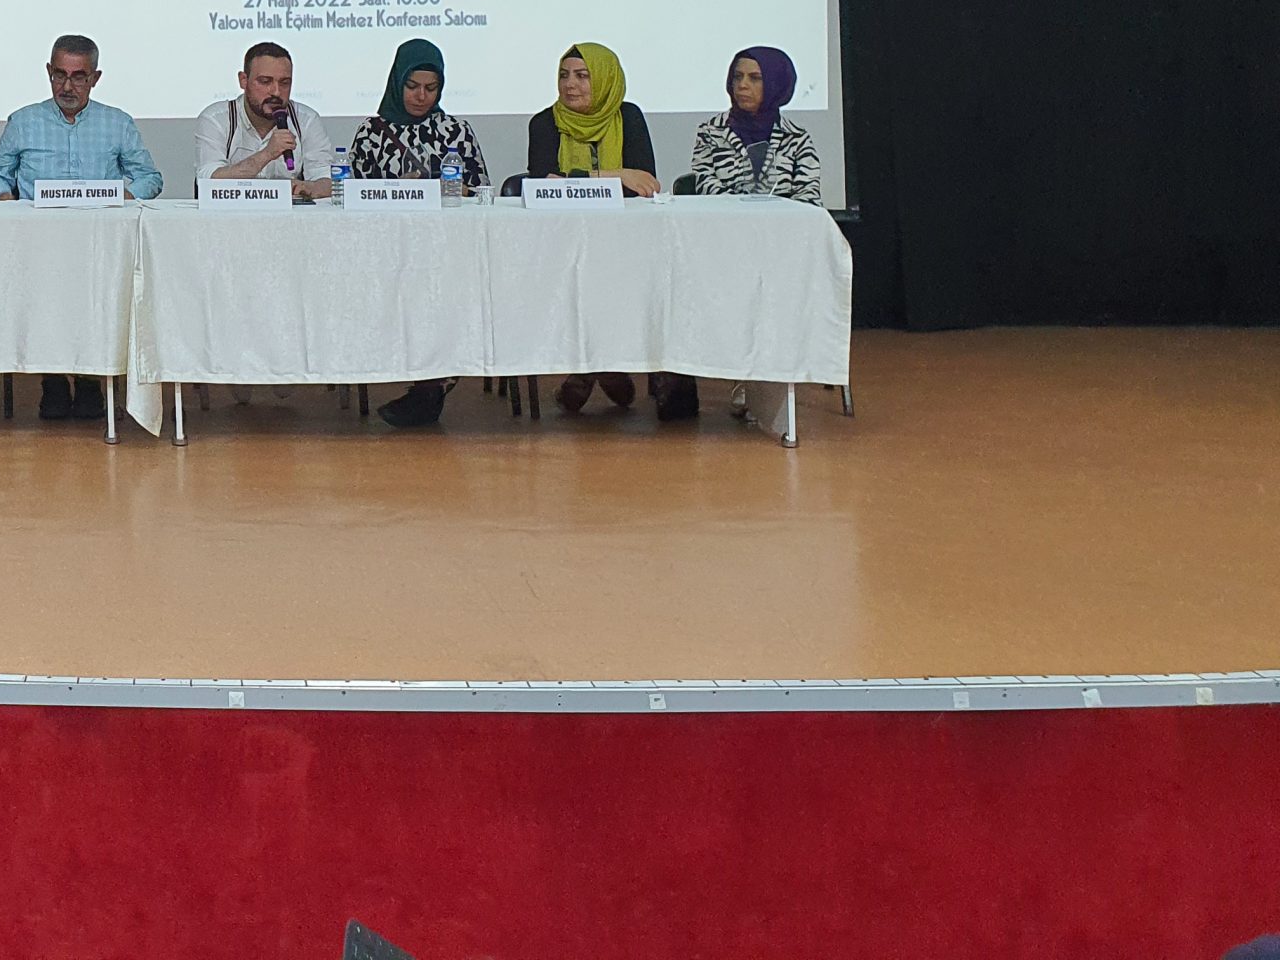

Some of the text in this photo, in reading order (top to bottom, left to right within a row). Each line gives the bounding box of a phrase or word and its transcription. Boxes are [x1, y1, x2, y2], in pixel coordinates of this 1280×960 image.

[209, 12, 254, 30] Yalova
[257, 11, 282, 29] Halk
[326, 10, 373, 29] Merkez
[376, 9, 441, 27] Konferans
[444, 8, 487, 26] Salonu
[40, 187, 118, 199] MUSTAFA EVERDİ
[211, 189, 279, 199] RECEP KAYALI
[360, 189, 424, 200] SEMA BAYAR
[535, 186, 612, 199] ARZU ÖZDEMİR
